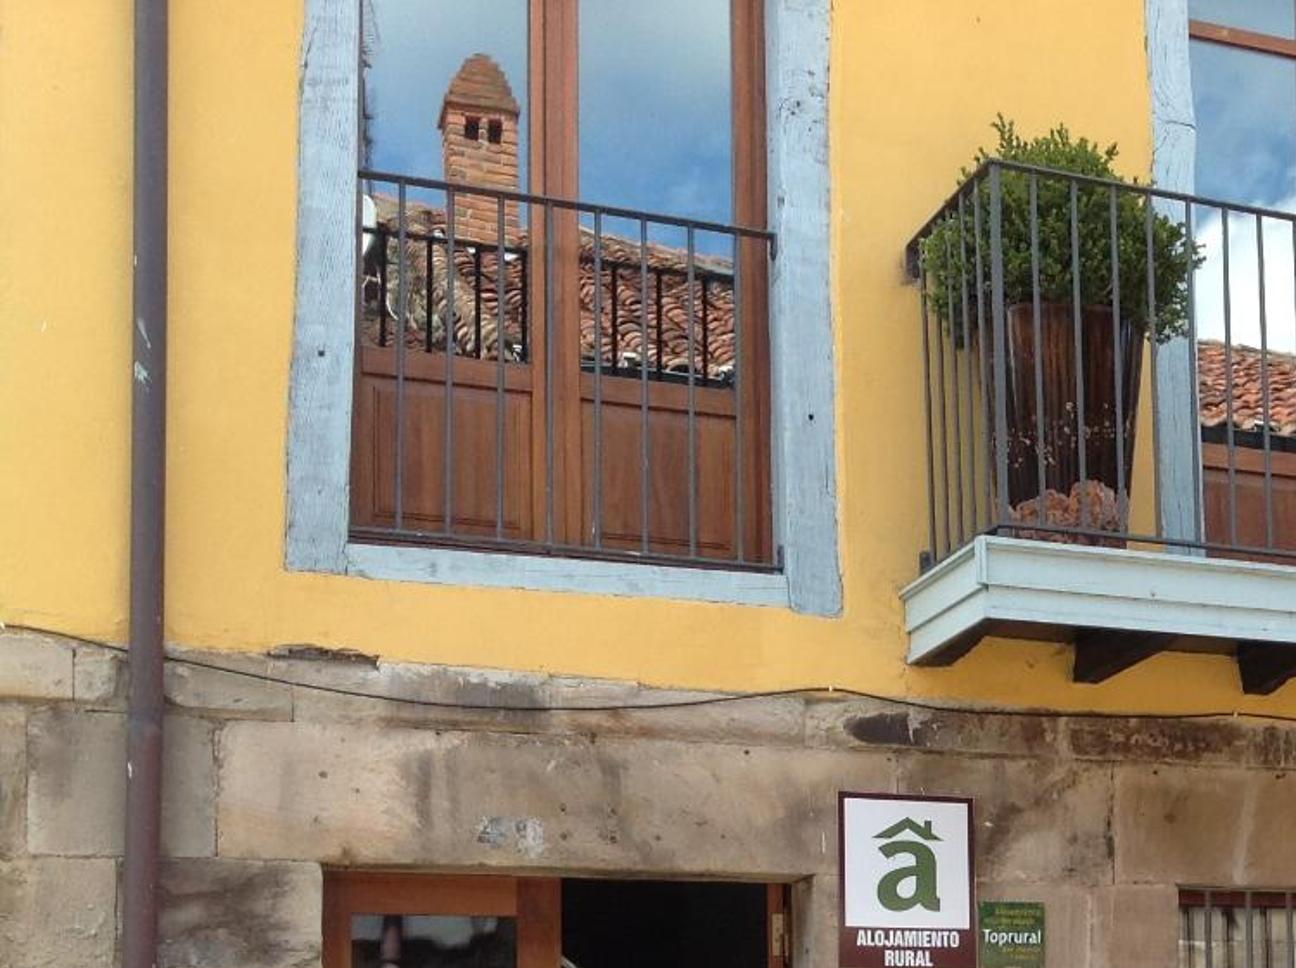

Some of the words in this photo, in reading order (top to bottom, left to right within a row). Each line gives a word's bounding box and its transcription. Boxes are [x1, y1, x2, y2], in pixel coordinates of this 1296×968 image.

[856, 929, 960, 948] ALOJAMIENTO
[982, 928, 1042, 947] Toprural
[884, 949, 934, 967] RURAL
